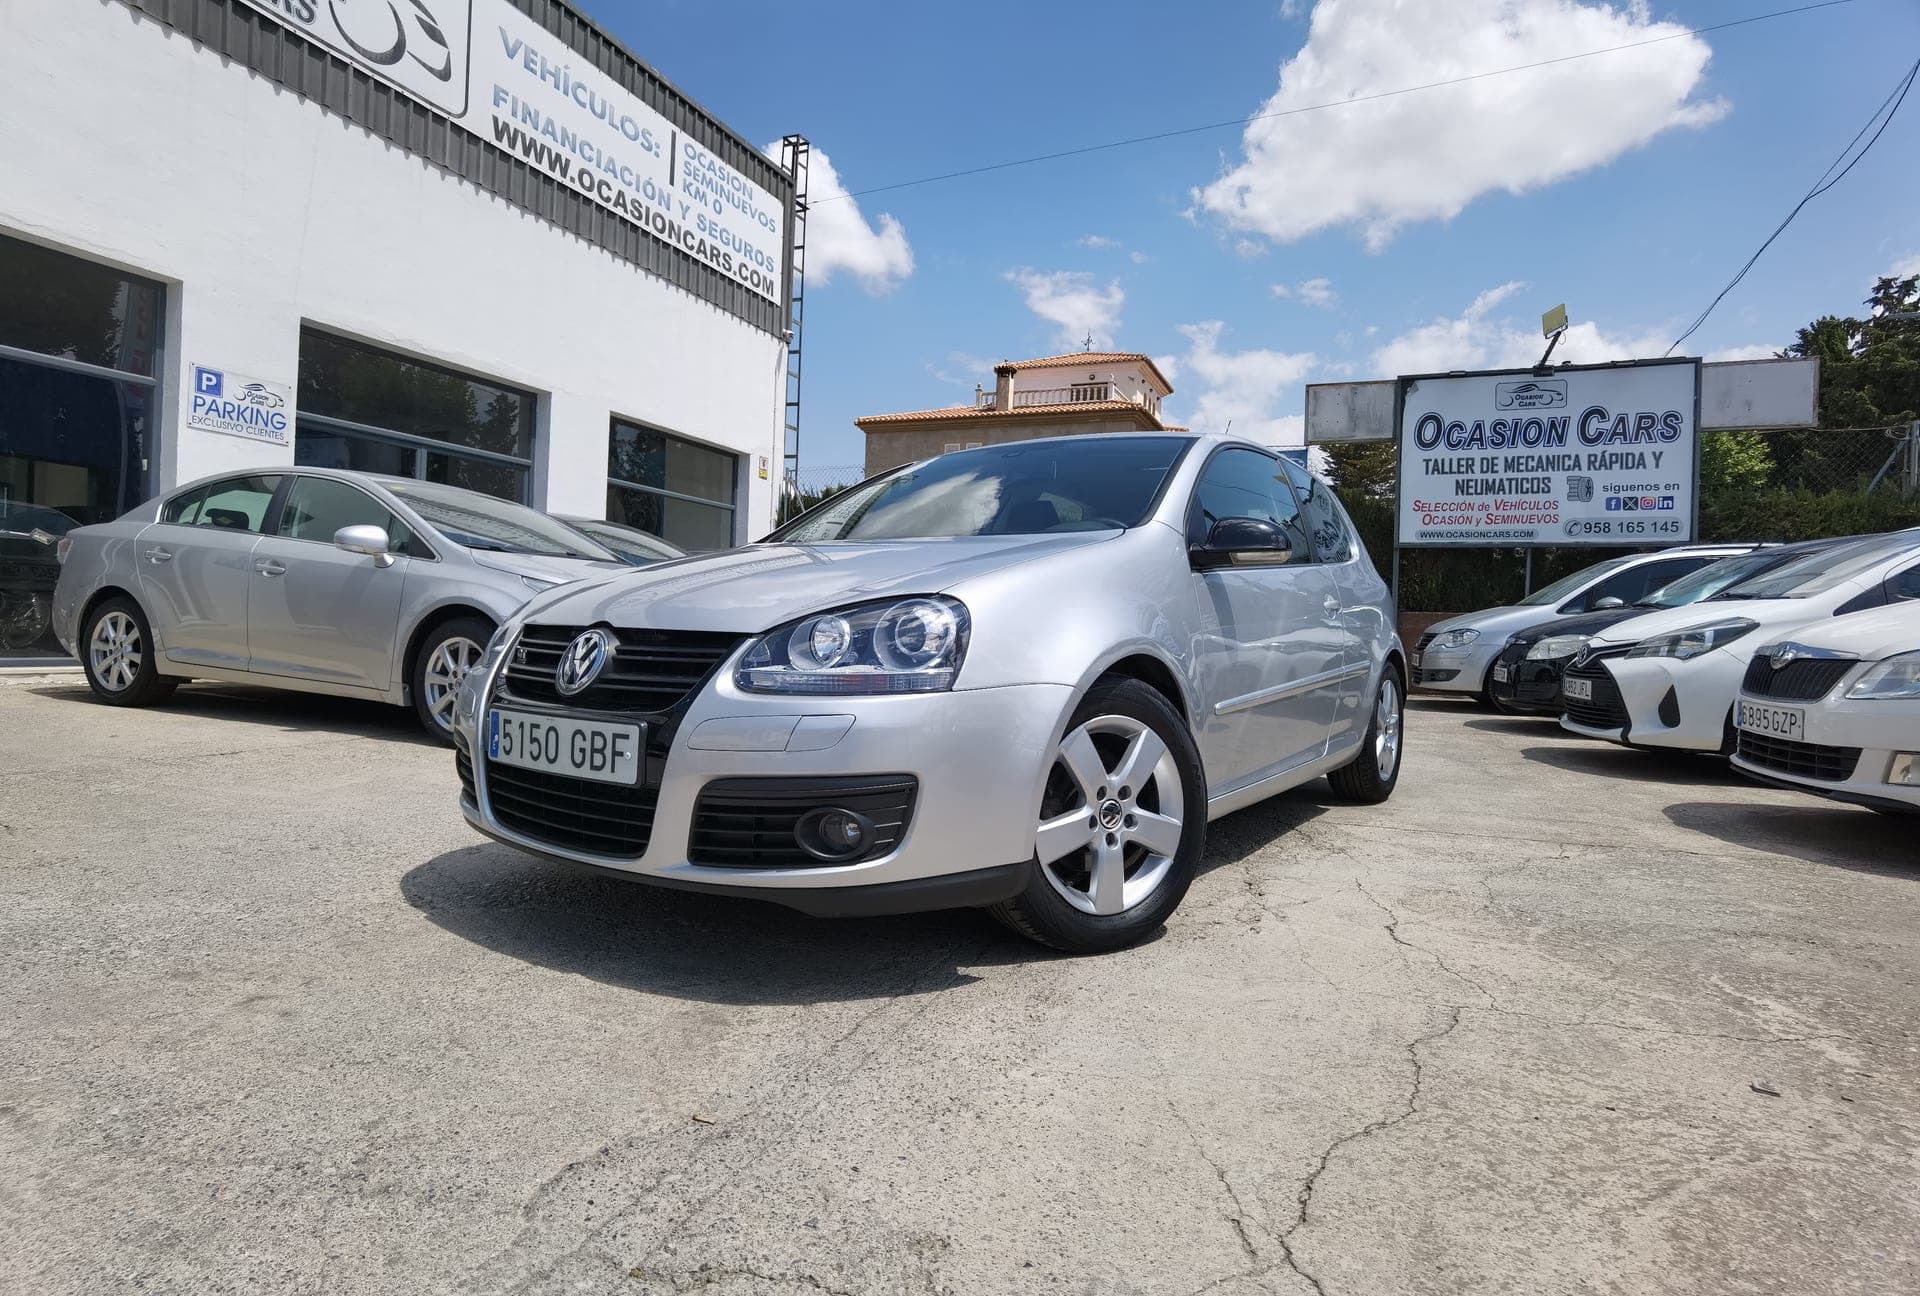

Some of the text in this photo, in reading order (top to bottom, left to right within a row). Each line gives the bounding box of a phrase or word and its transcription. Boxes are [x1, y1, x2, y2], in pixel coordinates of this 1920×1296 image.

[498, 25, 660, 158] VEHÍCULOS:
[493, 83, 775, 273] FINANCIACIÓN Y SEGUROS
[684, 142, 753, 201] OCASION
[492, 113, 775, 298] WWW.OCASIONCARS.COM
[682, 178, 708, 207] KM
[683, 160, 776, 233] SEMINUEVOS
[201, 372, 218, 391] P
[191, 414, 285, 441] EXCLUSIVO CLIENTES
[192, 395, 287, 431] PARKING
[1414, 405, 1684, 451] OCASION CARS
[1423, 450, 1664, 476] TALLER DE MECANICA RÁPIDA Y
[1455, 476, 1552, 496] NEUMATICOS
[1664, 483, 1680, 491] en
[1477, 501, 1490, 512] de
[1419, 530, 1535, 539] WWW.OCASIONCARS.COM
[1475, 518, 1482, 527] y
[1583, 520, 1679, 534] 958 165 145
[1743, 705, 1797, 735] 6895 GZP
[502, 718, 630, 774] 5150 GBF
